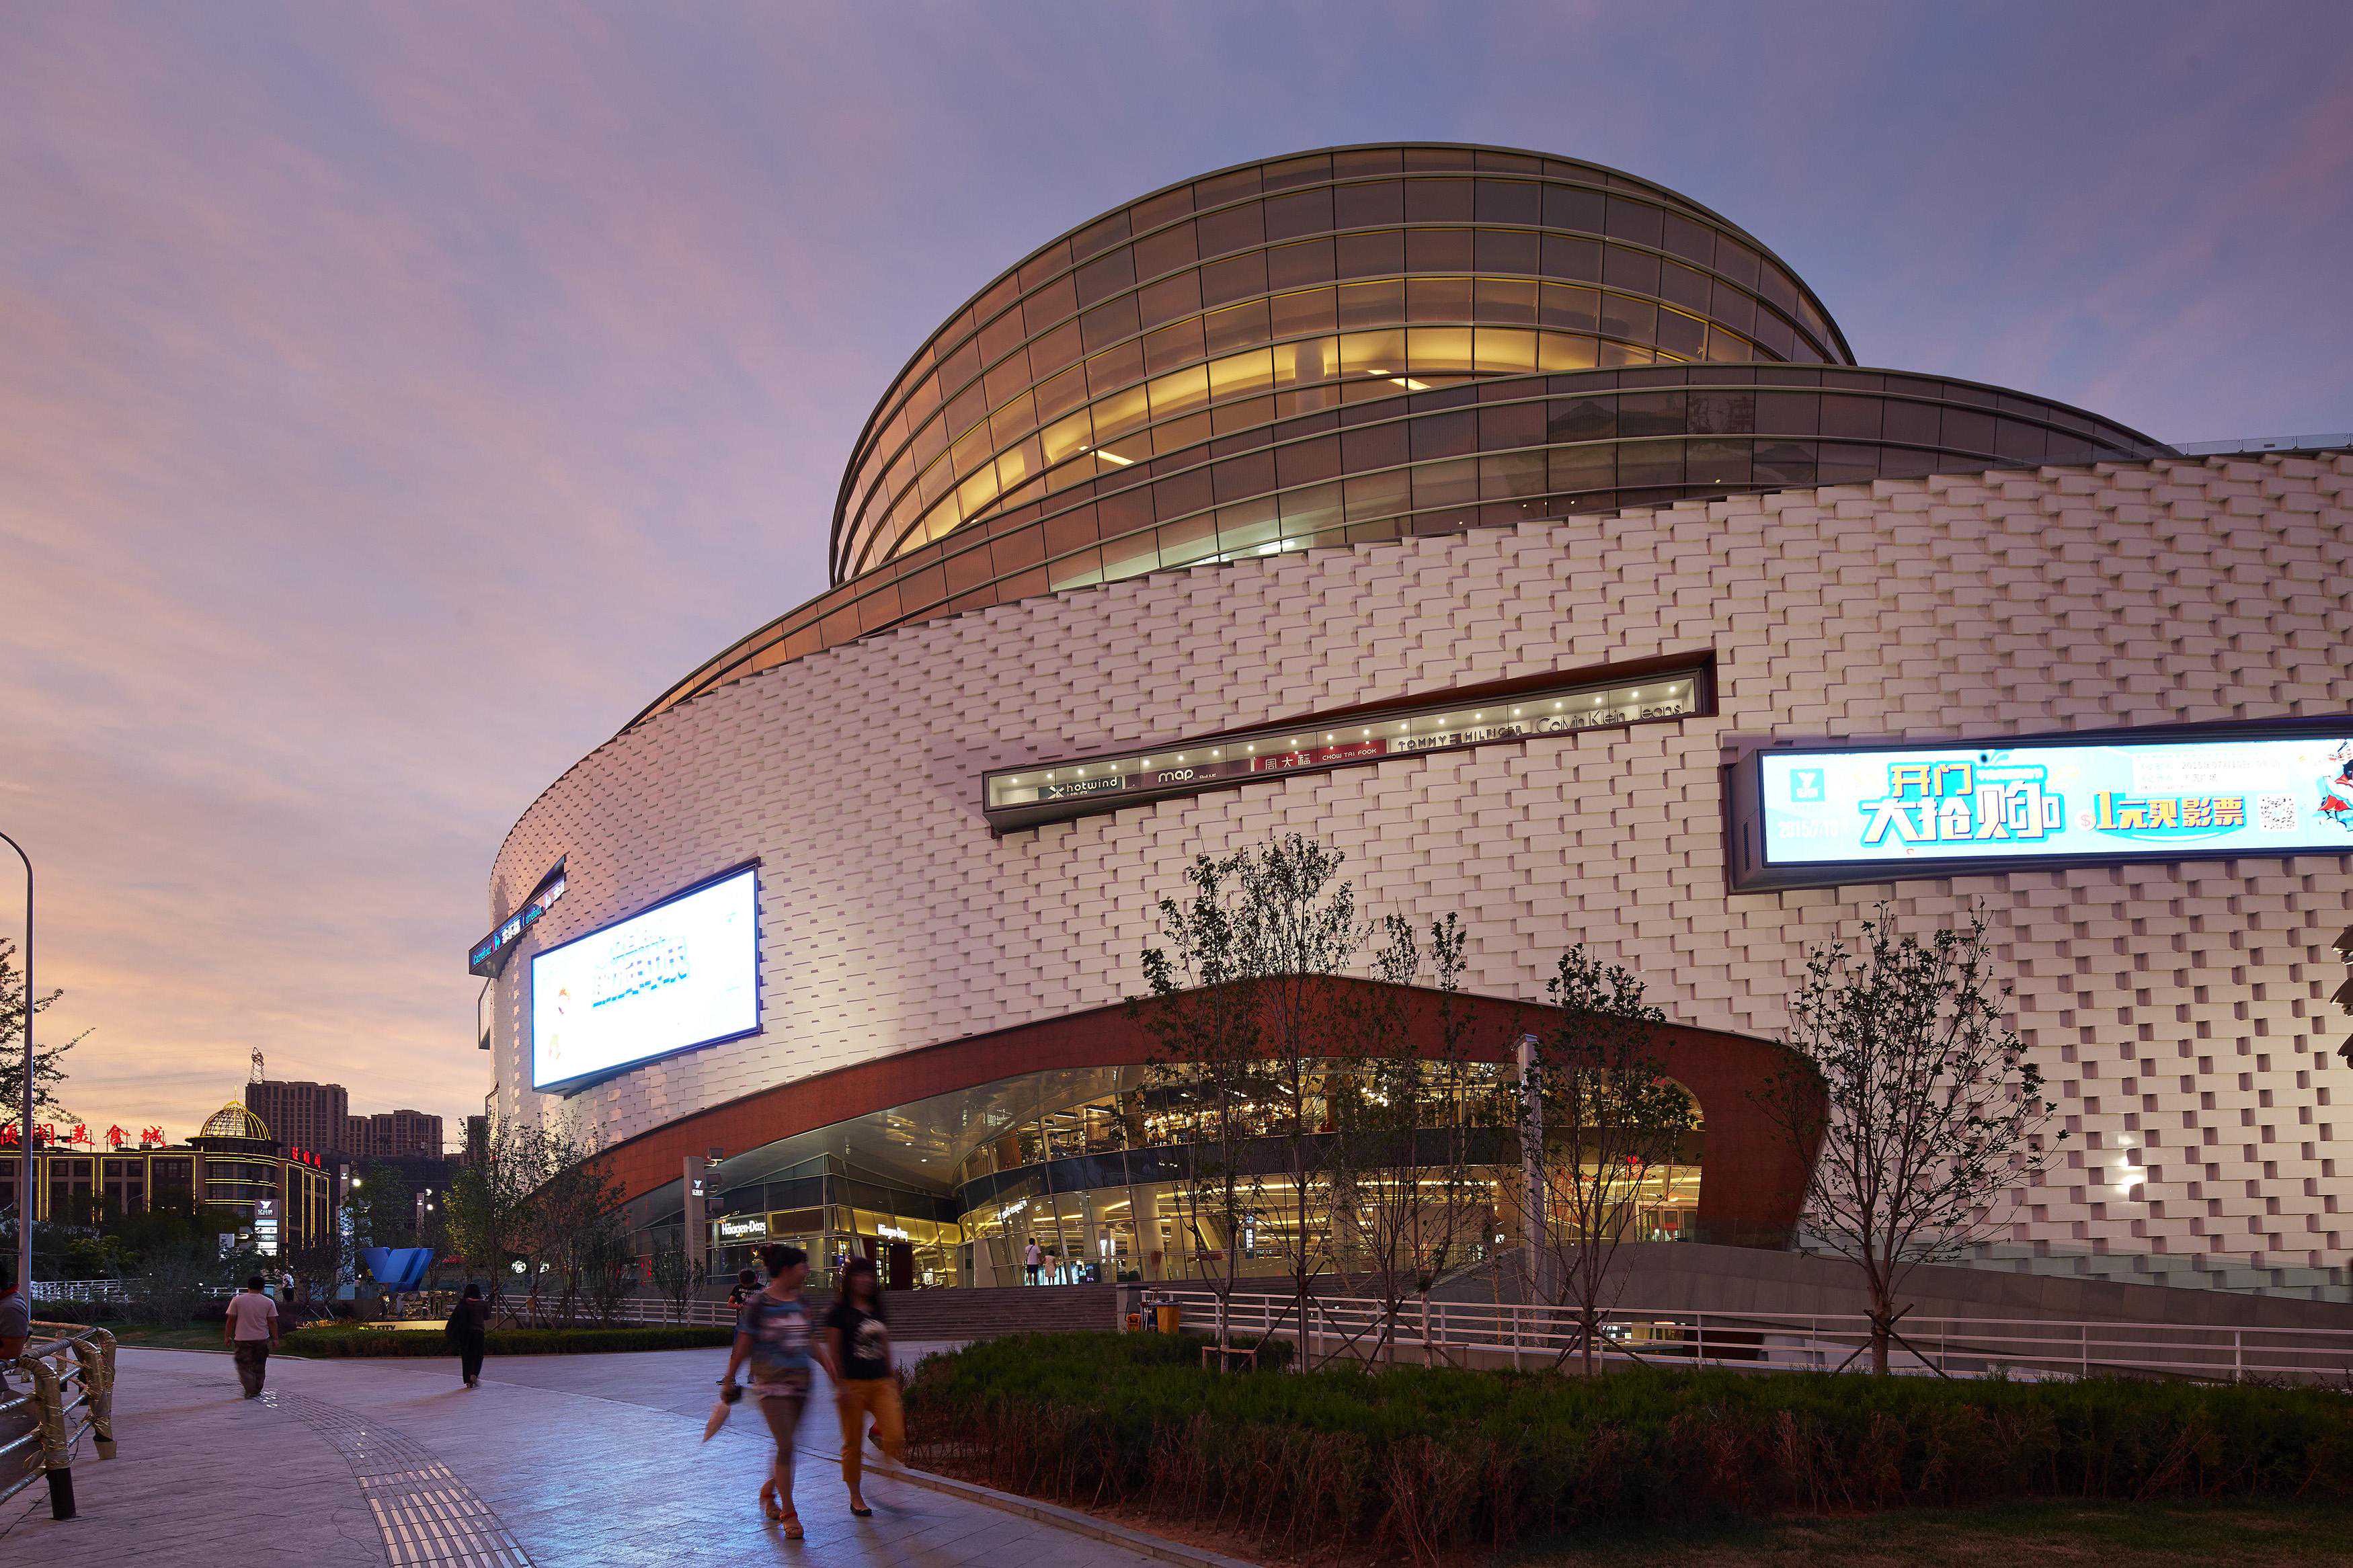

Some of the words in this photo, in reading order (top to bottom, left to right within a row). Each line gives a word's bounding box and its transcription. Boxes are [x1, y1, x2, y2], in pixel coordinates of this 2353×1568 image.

[1537, 715, 1585, 733] Calvin
[1588, 708, 1626, 725] Klein
[1632, 704, 1681, 721] Jeans
[1398, 735, 1447, 751] TOMMY
[1464, 725, 1523, 742] HILFIGER
[1265, 753, 1311, 770] 周大福
[1322, 753, 1342, 761] CHOW
[1357, 748, 1377, 756] FOOK
[1066, 776, 1118, 792] hotwind
[1158, 768, 1194, 784] map
[1891, 764, 1973, 798] 开门
[2095, 790, 2245, 830] 1元买影票
